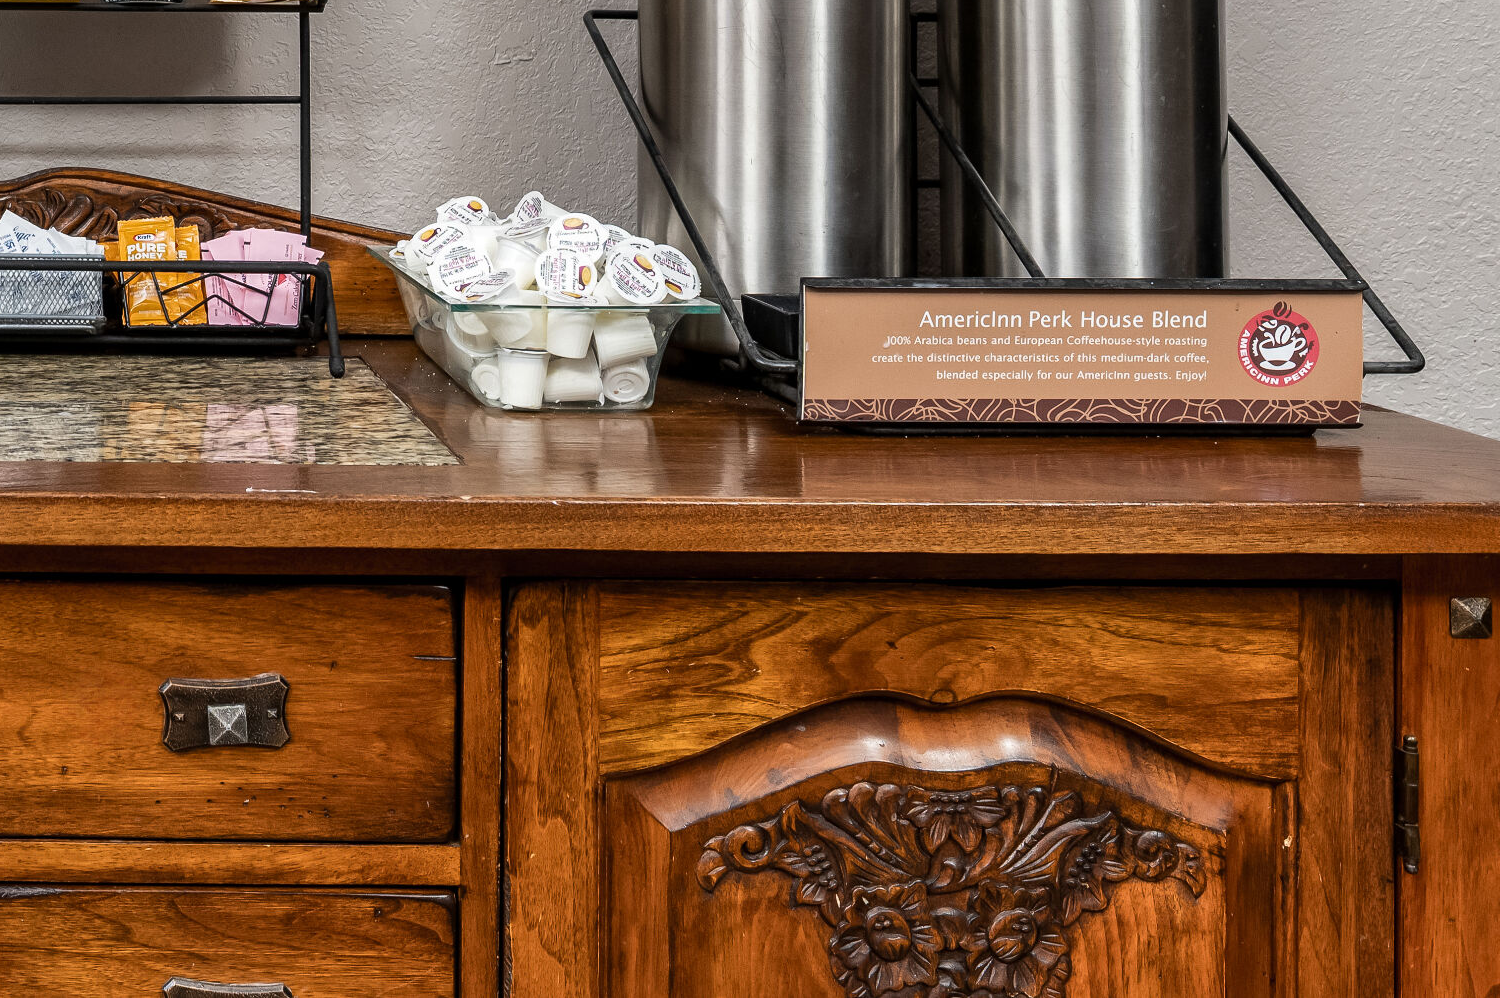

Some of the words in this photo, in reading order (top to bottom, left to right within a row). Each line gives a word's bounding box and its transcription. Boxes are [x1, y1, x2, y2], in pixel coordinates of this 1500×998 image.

[127, 242, 166, 254] PURE
[128, 252, 163, 261] HONEY
[919, 310, 1022, 328] AmericInn
[1029, 310, 1072, 328] Perk
[1081, 311, 1144, 328] House
[1152, 310, 1207, 328] Blend
[886, 336, 911, 345] 100%
[914, 336, 953, 345] Arabica
[957, 336, 987, 345] beans
[991, 336, 1010, 345] and
[1014, 336, 1063, 346] European
[1066, 336, 1160, 347] Coffeehouse-style
[1164, 336, 1207, 347] roasting
[872, 354, 903, 363] create
[907, 353, 923, 363] the
[927, 353, 980, 363] distinctive
[984, 353, 1059, 363] characteristics
[1063, 353, 1074, 363] of
[1077, 353, 1097, 363] this
[1101, 353, 1170, 363] medium-dark
[1174, 353, 1210, 364] coffee,
[1240, 330, 1279, 385] AMERICINN
[1284, 360, 1314, 384] PERK
[936, 370, 978, 380] blended
[982, 370, 1033, 382] especially
[1037, 370, 1052, 380] for
[1077, 371, 1130, 380] AmericInn
[1134, 372, 1171, 382] guests.
[1176, 370, 1207, 382] Enjoy!
